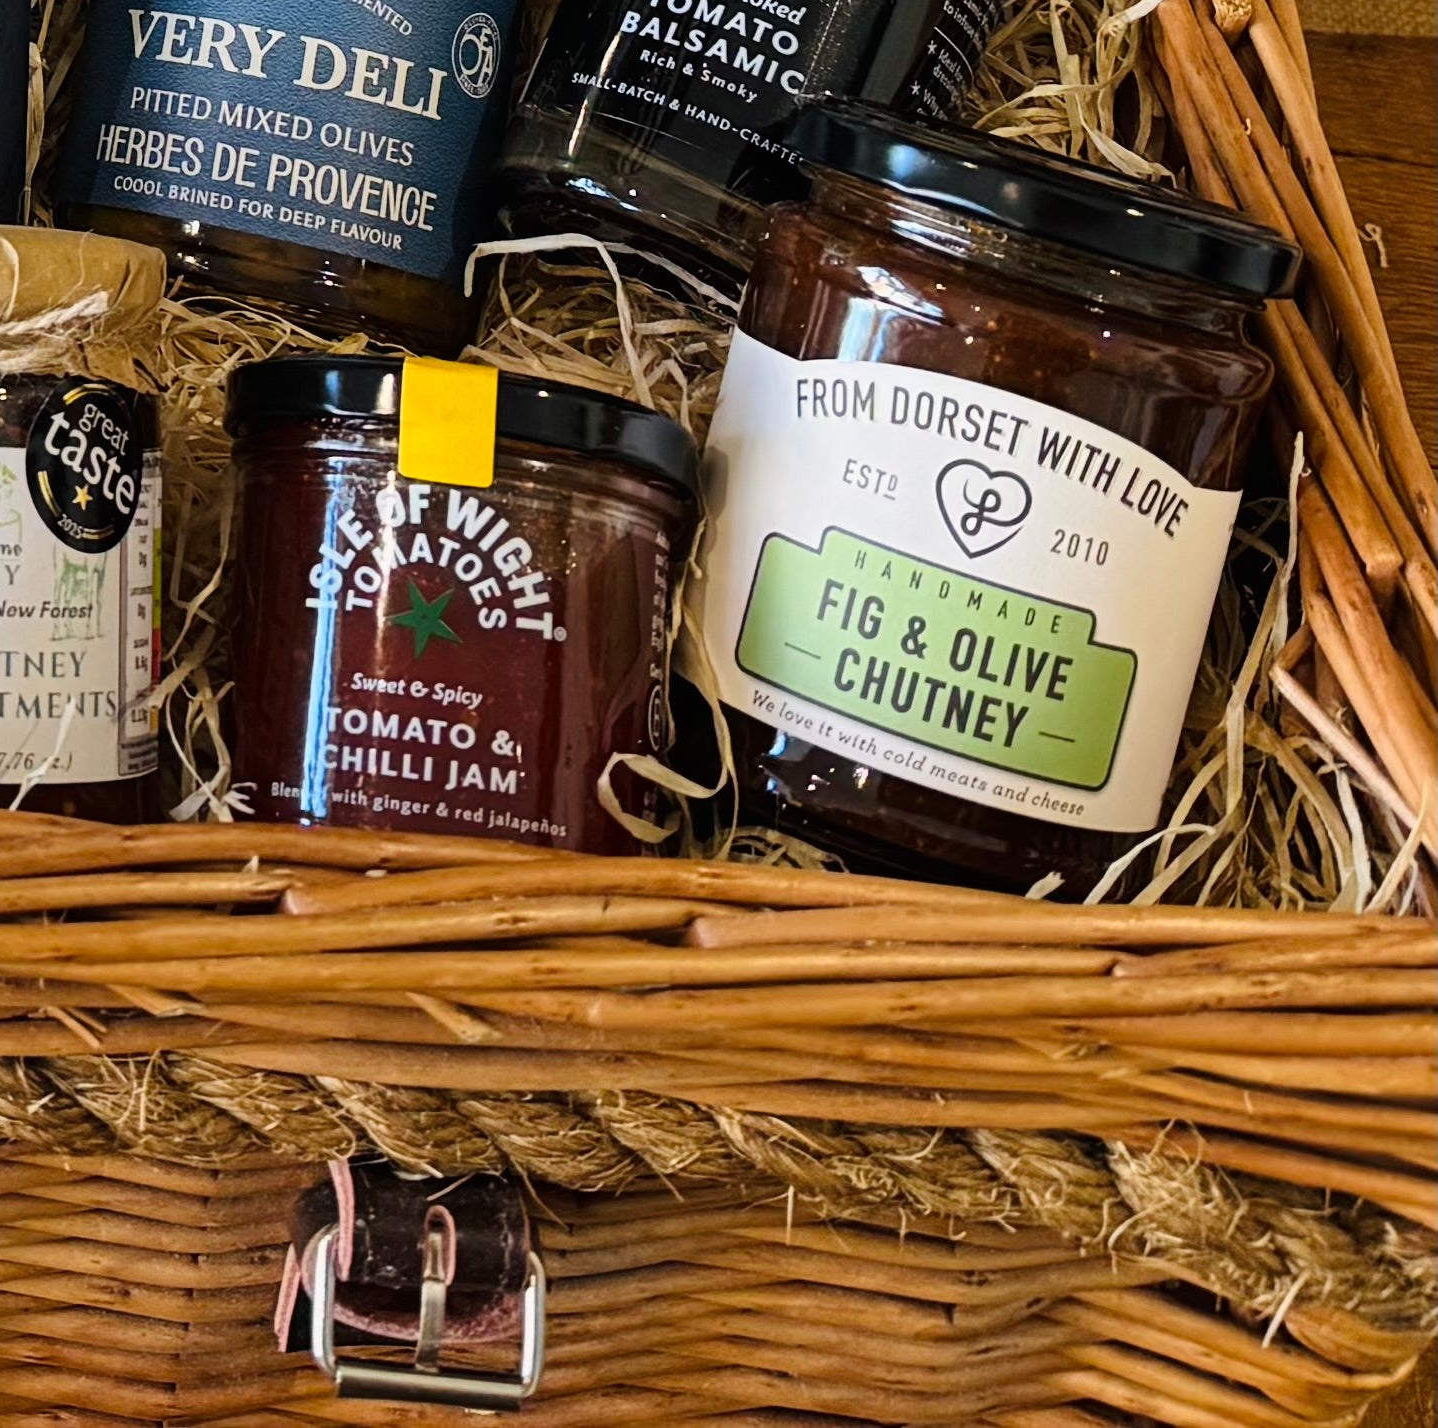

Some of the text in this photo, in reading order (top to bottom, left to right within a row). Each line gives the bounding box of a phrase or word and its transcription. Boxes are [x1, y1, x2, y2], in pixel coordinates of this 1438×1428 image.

[127, 7, 449, 121] VERY DELI
[619, 11, 806, 96] BALSAMIC
[130, 87, 415, 167] PITTED MIXED OLIVES
[168, 184, 402, 251] BRINED FOR DEEP FLAVOUR
[795, 377, 1190, 539] FROM DORSET WITH LOVE
[816, 578, 1074, 701] FIG & OLIVE
[351, 672, 483, 709] Sweet & Spicy
[833, 648, 1030, 748] CHUTNEY
[445, 760, 519, 795] JAM
[883, 742, 1085, 817] cold meats and cheese
